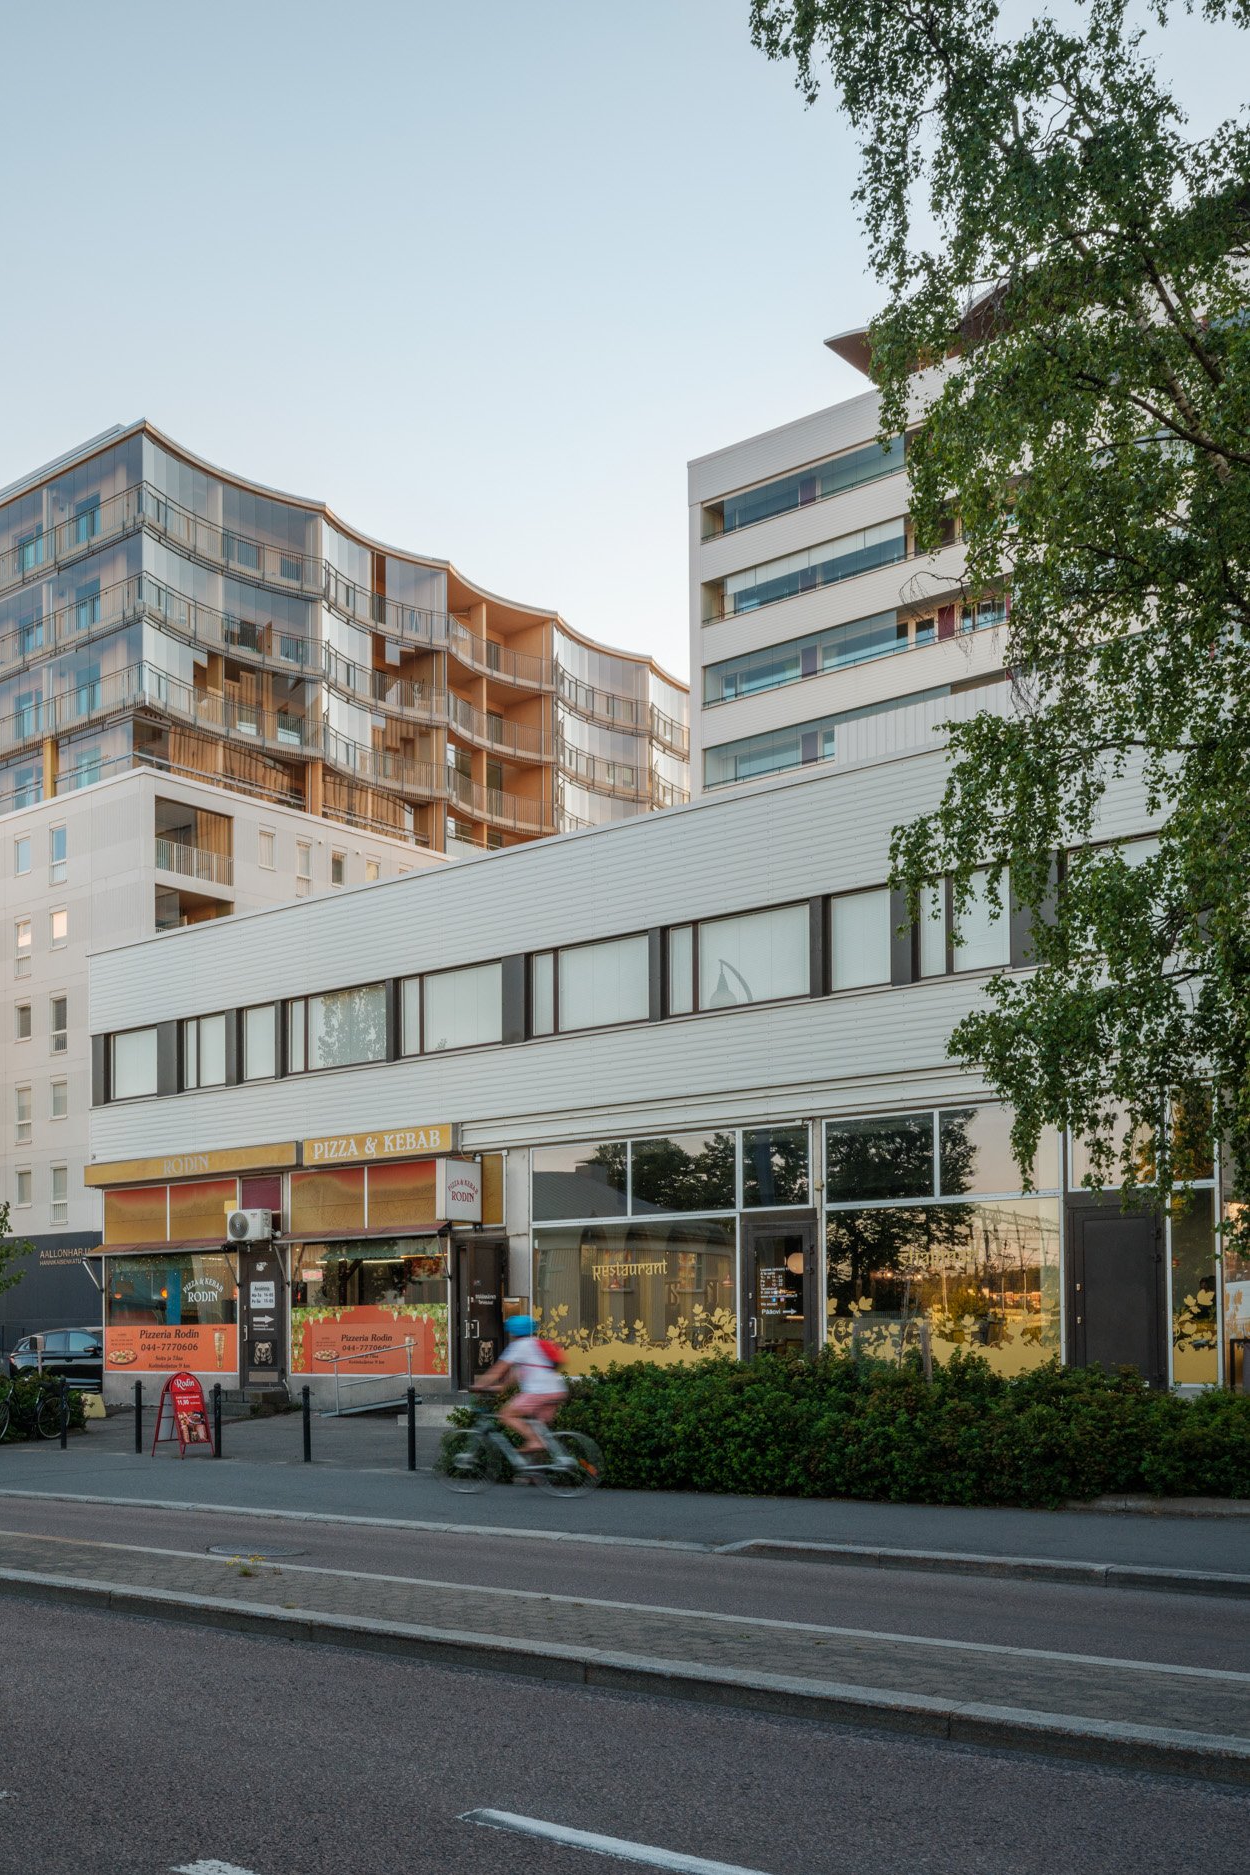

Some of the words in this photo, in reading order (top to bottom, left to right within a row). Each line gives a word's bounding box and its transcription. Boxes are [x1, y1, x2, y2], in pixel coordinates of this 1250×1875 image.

[313, 1140, 358, 1160] PIZZA
[364, 1137, 377, 1157] &
[383, 1130, 440, 1152] KEBAB
[163, 1154, 209, 1175] RODIN
[448, 1180, 460, 1191] PIZZA
[464, 1180, 478, 1195] KEBAB
[451, 1191, 474, 1202] RODIN
[592, 1258, 668, 1281] Restaurant
[182, 1280, 198, 1293] PIZZA
[198, 1277, 205, 1285] &
[205, 1277, 224, 1293] KEBAB
[187, 1291, 218, 1303] RODIN
[139, 1329, 171, 1339] Pizzeria
[174, 1328, 199, 1339] Rodin
[341, 1334, 368, 1342] Pizzeria
[371, 1333, 393, 1342] Rodin
[141, 1343, 198, 1351] 044-7770606
[174, 1378, 195, 1390] Rodin
